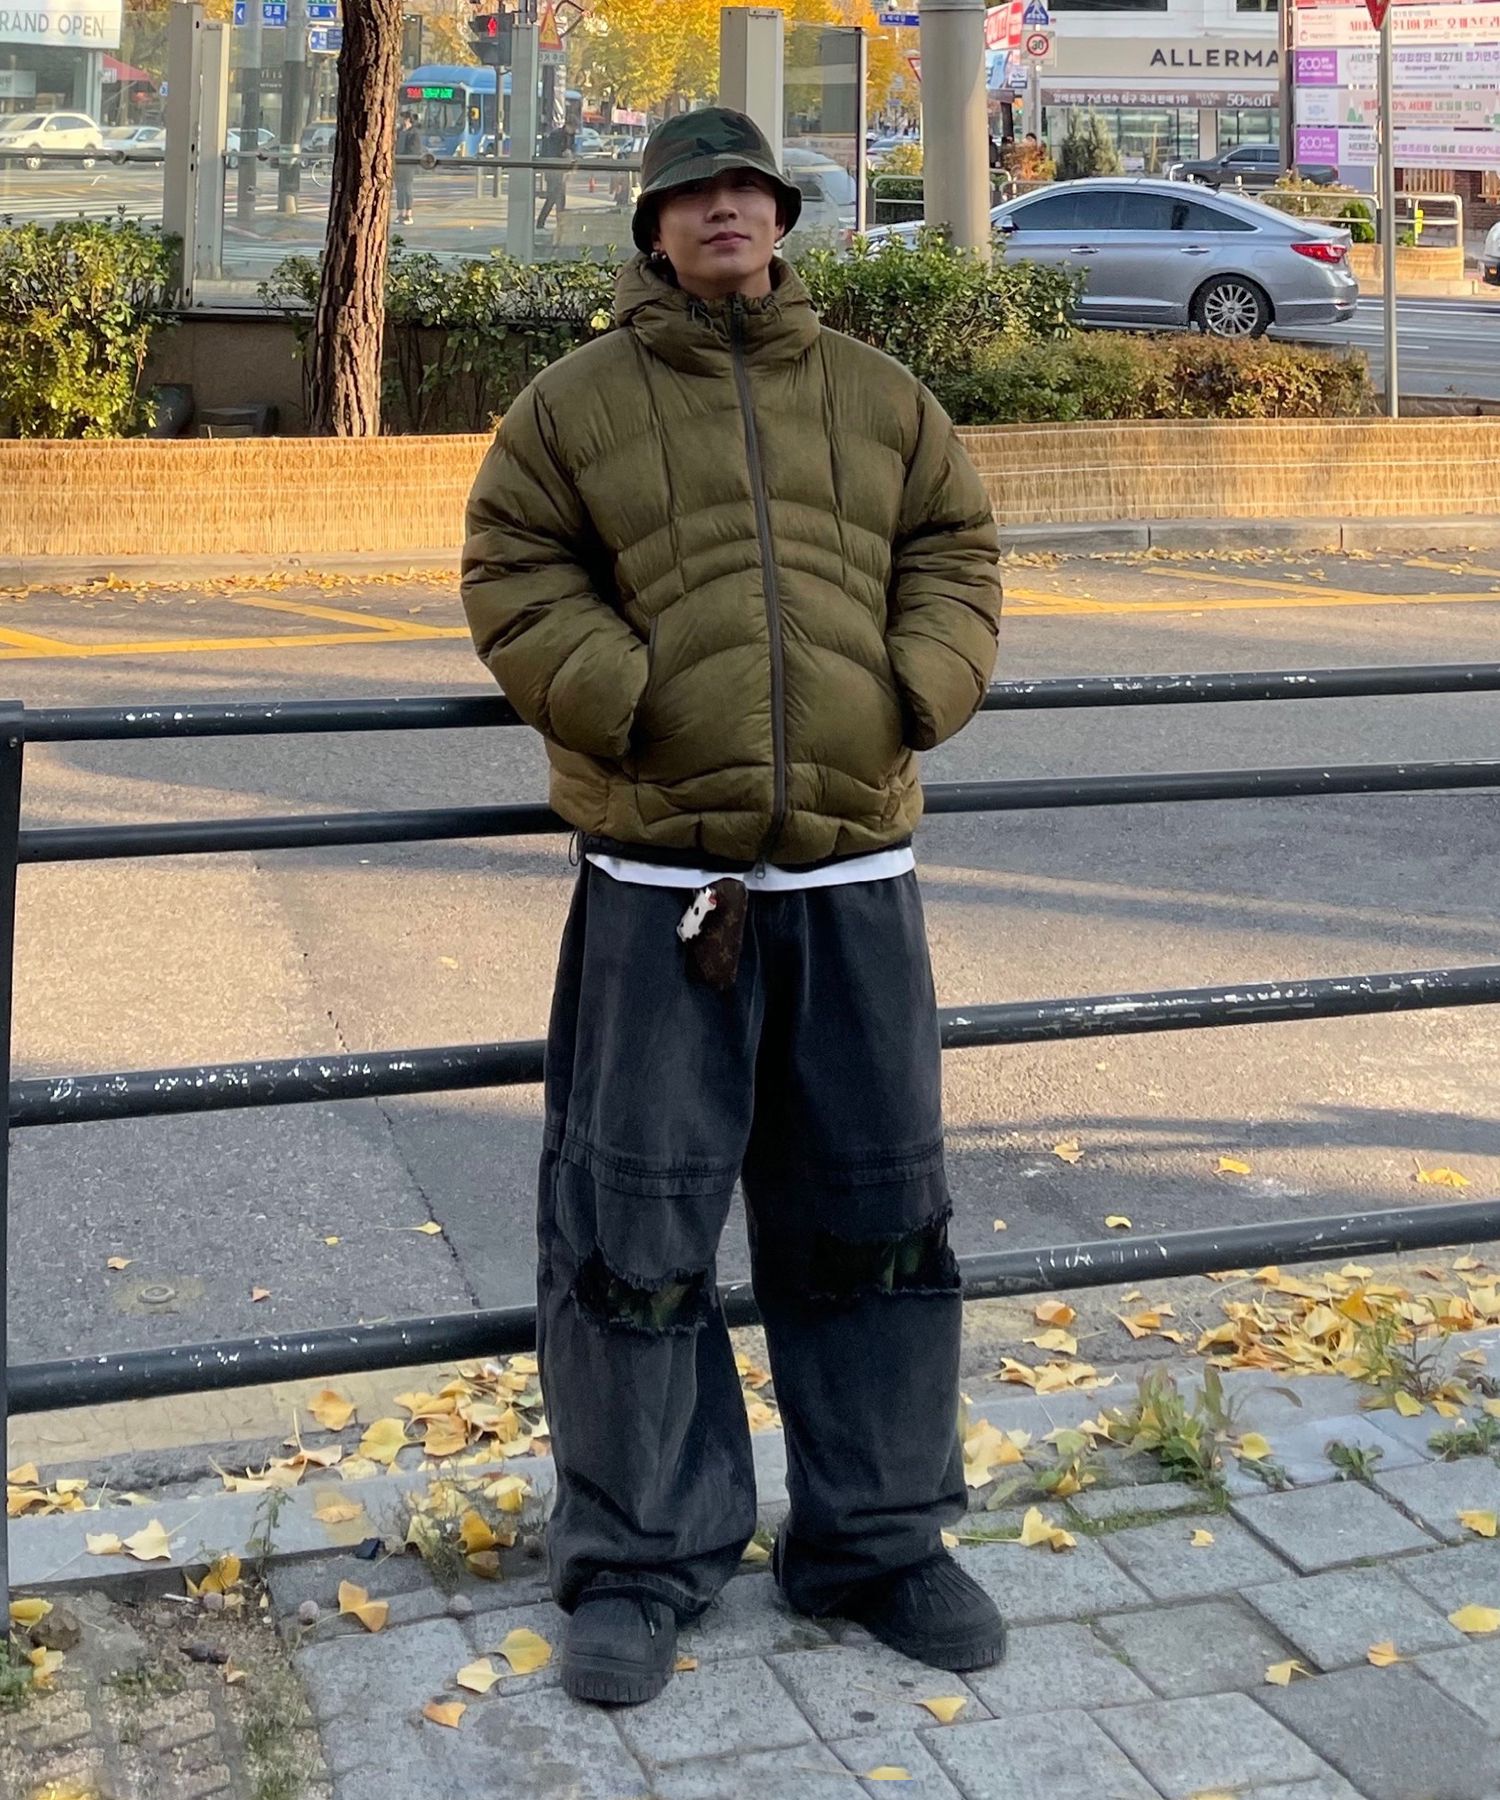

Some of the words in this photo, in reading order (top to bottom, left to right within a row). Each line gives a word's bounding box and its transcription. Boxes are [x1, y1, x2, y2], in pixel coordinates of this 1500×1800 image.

[0, 11, 49, 32] RAND
[58, 15, 104, 38] OPEN
[1031, 40, 1044, 50] 30
[1150, 48, 1279, 67] ALLERMA
[1298, 58, 1321, 70] 200
[1299, 137, 1322, 149] 200
